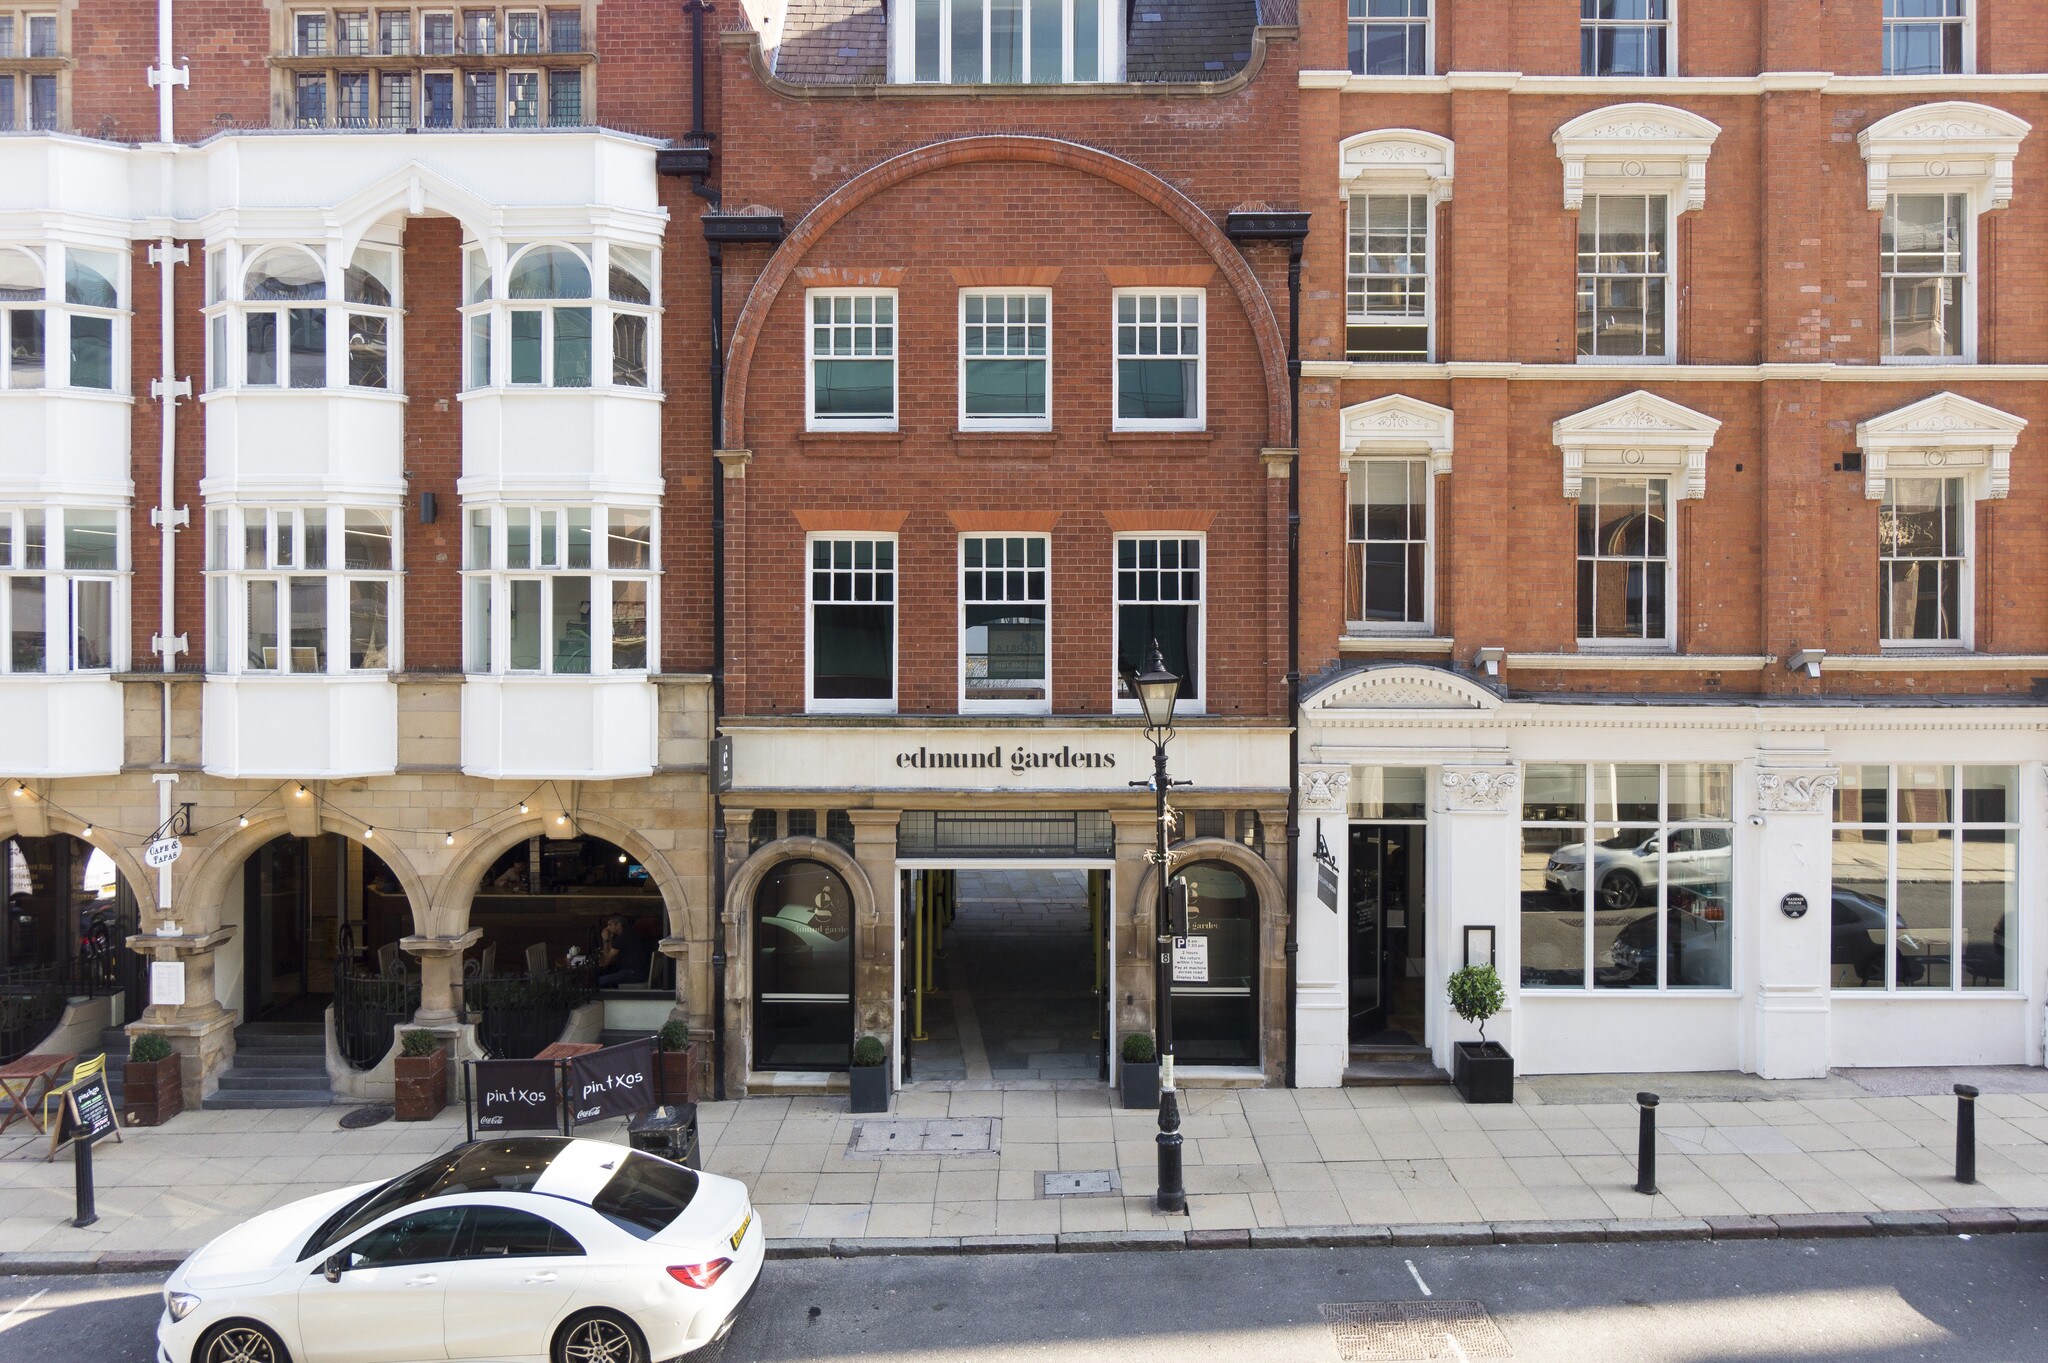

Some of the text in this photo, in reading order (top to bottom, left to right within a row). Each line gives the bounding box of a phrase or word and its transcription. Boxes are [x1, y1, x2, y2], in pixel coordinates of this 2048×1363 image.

[896, 746, 1116, 776] edmund gardens
[171, 840, 178, 850] &
[153, 852, 178, 865] TAPAS
